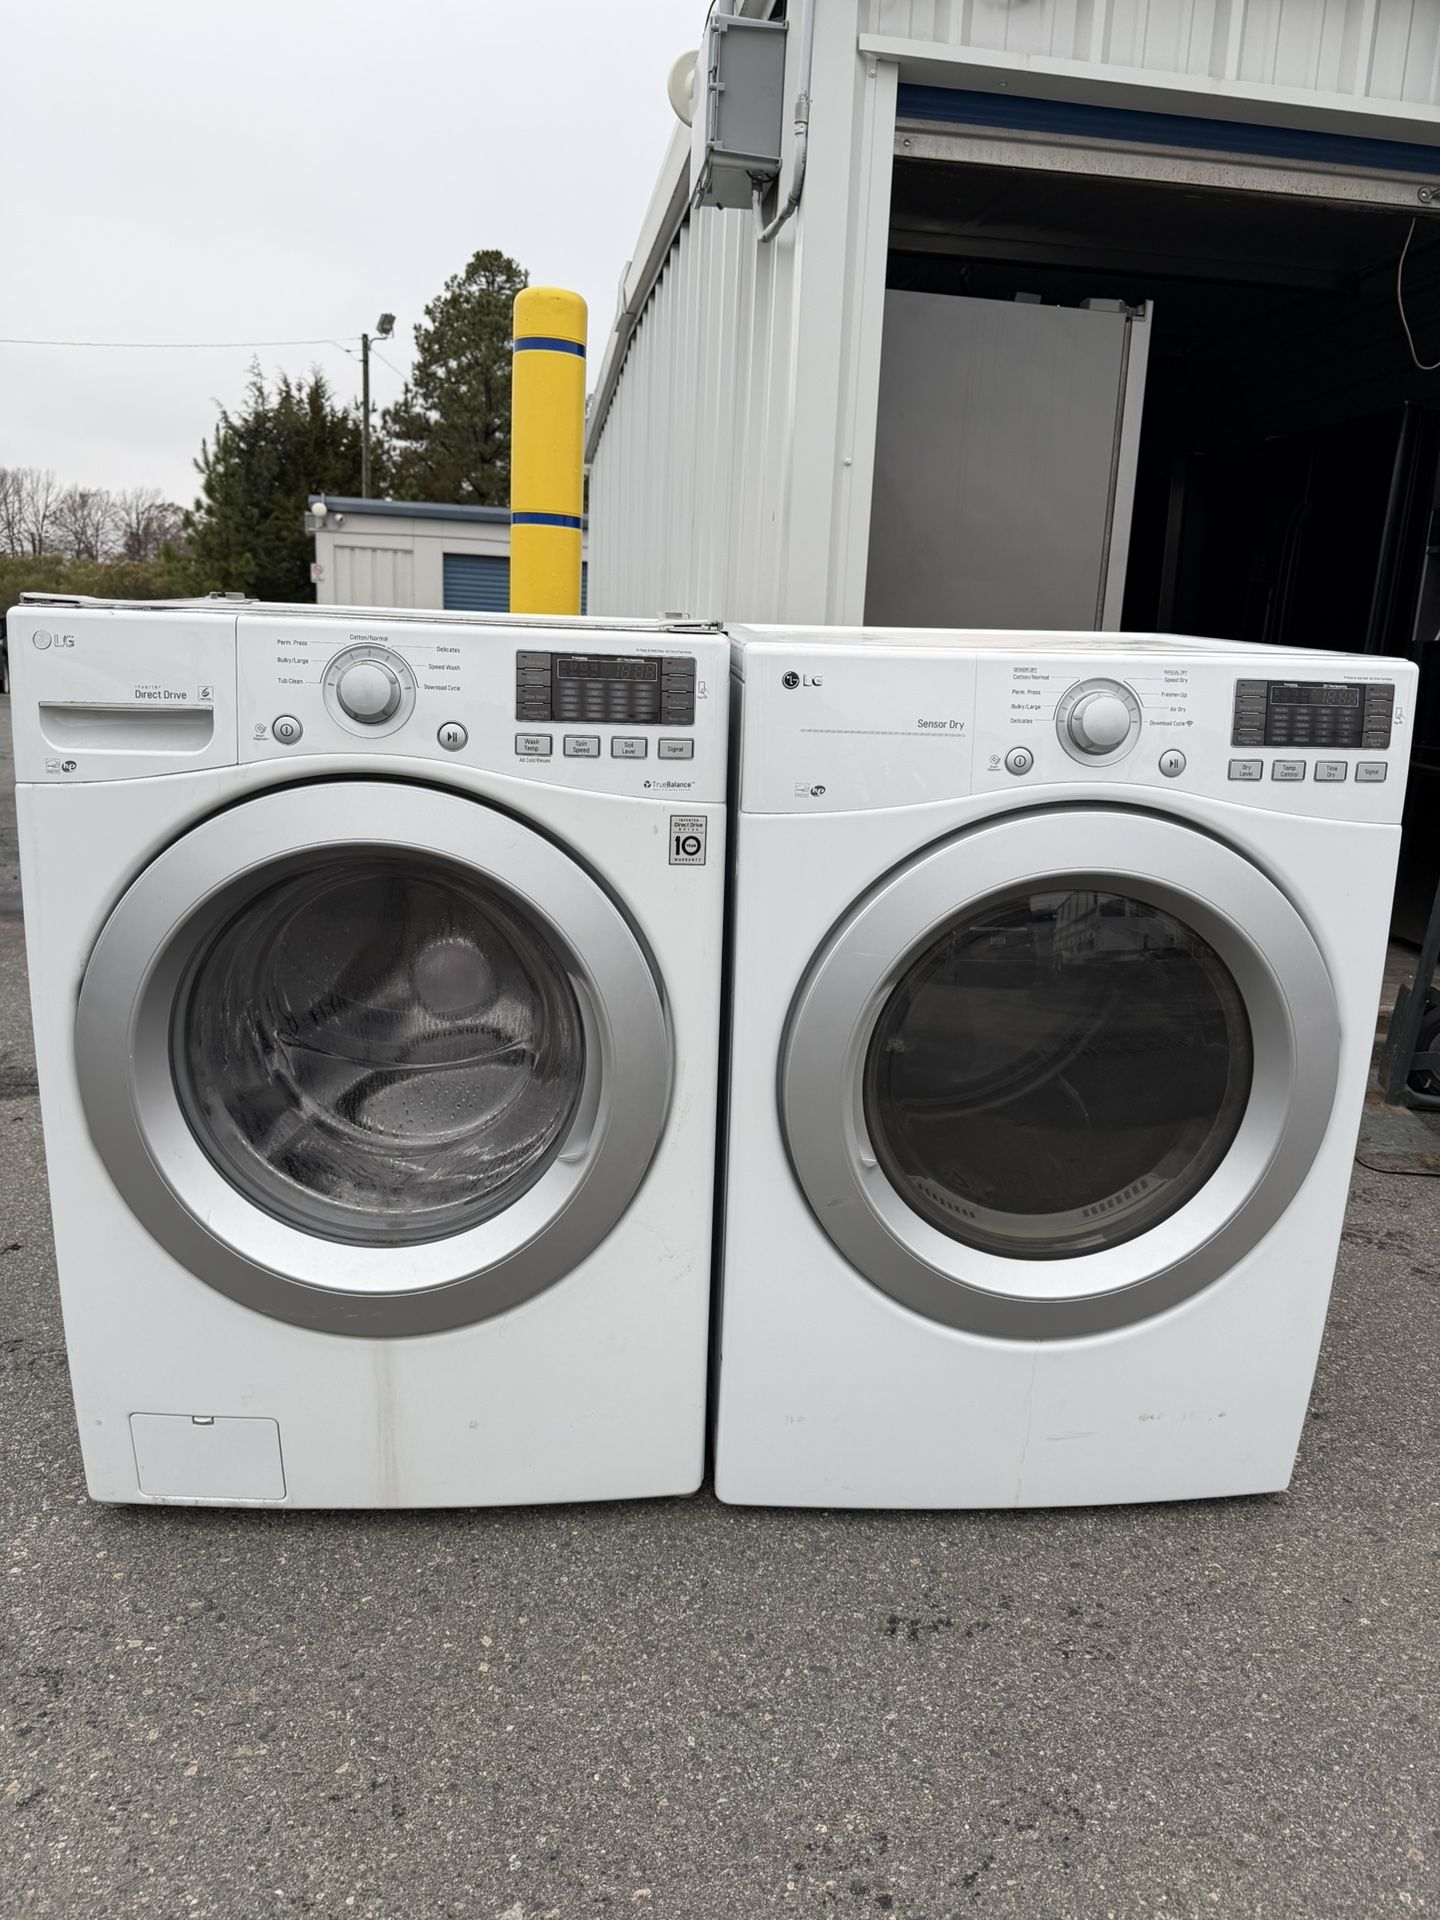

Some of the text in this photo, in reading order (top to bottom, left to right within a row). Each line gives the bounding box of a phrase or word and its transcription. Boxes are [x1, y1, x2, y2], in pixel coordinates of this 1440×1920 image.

[54, 634, 76, 648] LG
[350, 634, 388, 642] Cotton/Normal
[436, 646, 461, 654] Delicates
[803, 674, 824, 687] LG
[1164, 676, 1179, 684] Speed
[135, 690, 187, 700] Direct Drive
[917, 718, 965, 731] Sensor Dry
[1173, 720, 1186, 728] Cycle
[576, 740, 588, 748] Spin
[573, 746, 590, 754] Speed
[668, 746, 684, 754] Signal
[1365, 768, 1379, 776] Signal
[675, 836, 701, 856] 10
